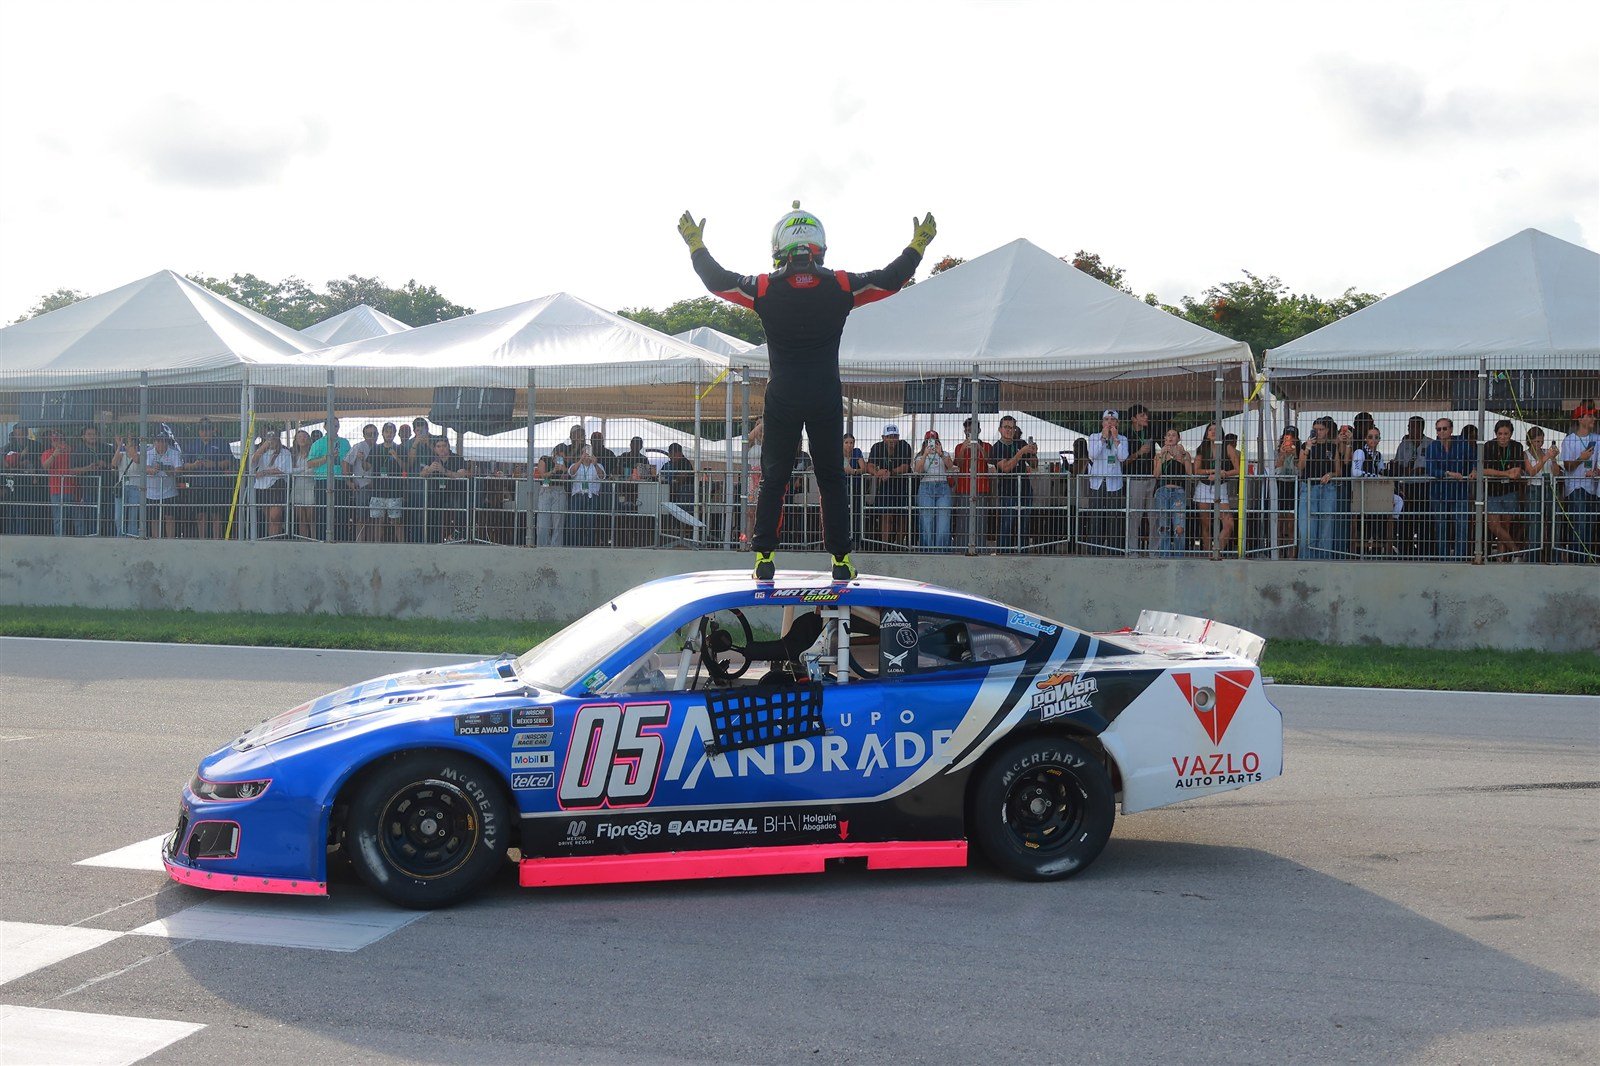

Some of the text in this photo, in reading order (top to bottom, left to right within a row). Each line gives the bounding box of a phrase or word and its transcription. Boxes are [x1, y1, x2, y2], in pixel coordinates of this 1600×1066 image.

[754, 591, 765, 599] 05
[772, 588, 832, 597] MATEO
[1011, 611, 1057, 636] Pascual
[1043, 694, 1089, 719] DUCK
[460, 726, 509, 735] POLE AWARD
[514, 755, 548, 764] Mobil 1
[558, 702, 671, 809] 05
[1172, 752, 1260, 777] VAZLO
[514, 774, 552, 788] telcel
[1175, 773, 1262, 788] AUTO PARTS
[802, 813, 837, 824] Holguín
[667, 819, 758, 836] QARDEAL
[802, 823, 837, 832] Abogados
